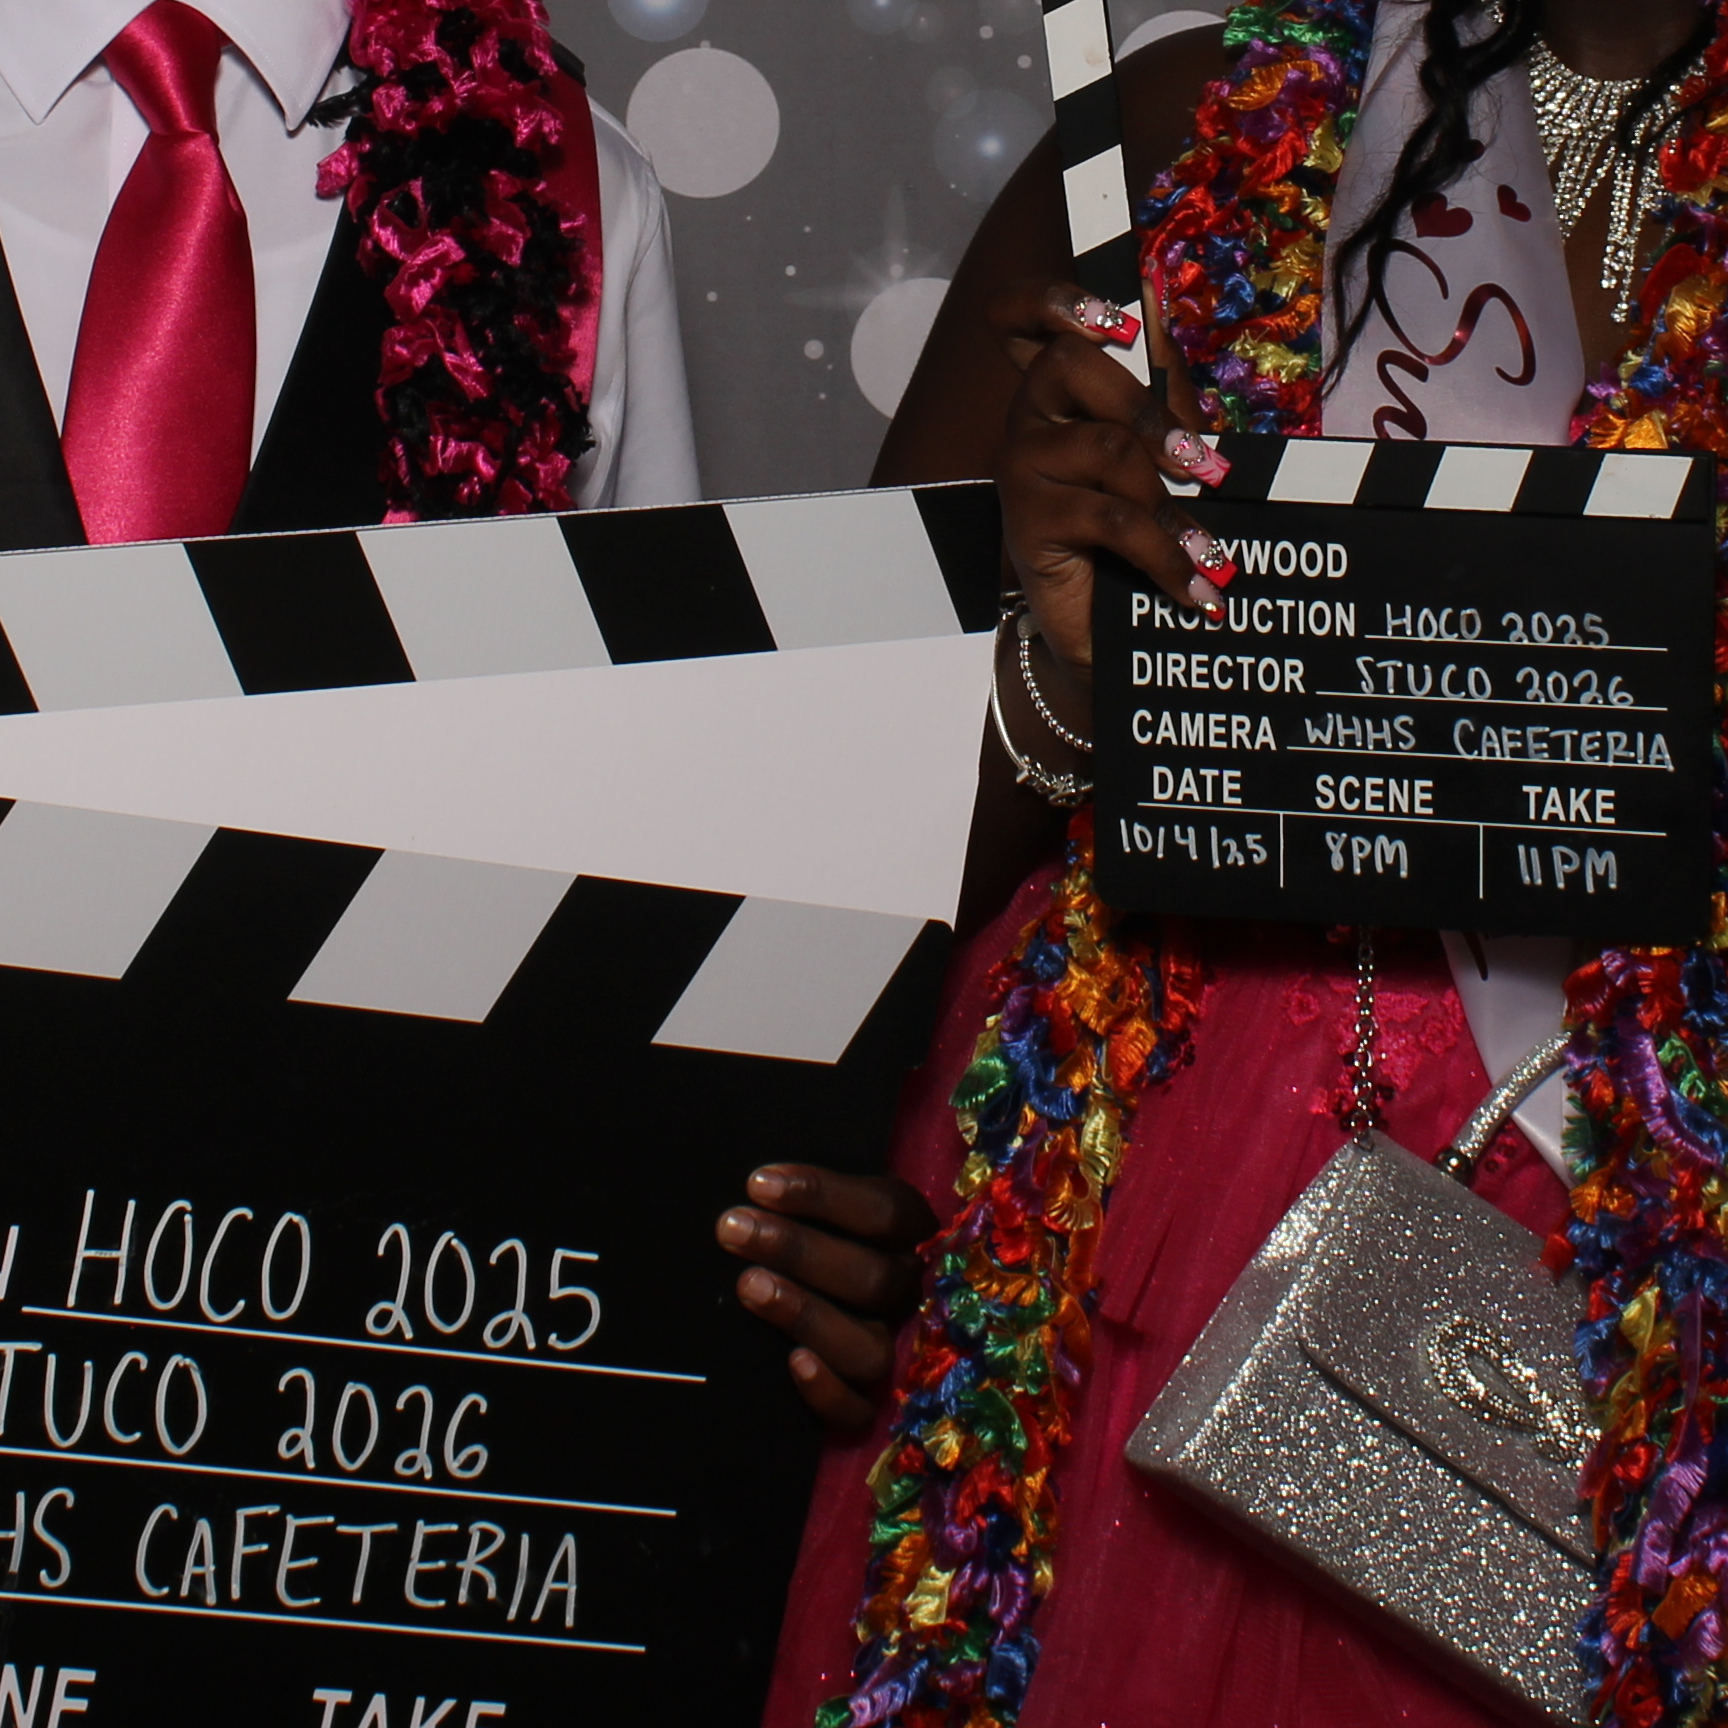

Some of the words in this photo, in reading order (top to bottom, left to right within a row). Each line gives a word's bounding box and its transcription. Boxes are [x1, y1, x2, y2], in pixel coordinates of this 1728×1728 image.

[1385, 603, 1482, 641] HOCO
[1502, 611, 1610, 647] 2025
[1132, 650, 1306, 694] DIRECTOR
[1355, 655, 1492, 700] STUCO
[1516, 666, 1634, 707] 2026
[1132, 709, 1277, 751] CAMERA
[1304, 712, 1416, 751] WHHS
[1454, 717, 1674, 772] CAFETERIA
[1152, 765, 1242, 805] DATE
[1314, 774, 1434, 815] SCENE
[1521, 784, 1616, 825] TAKE
[1325, 831, 1408, 879] 8PM
[66, 1188, 311, 1323] HOCO
[365, 1222, 601, 1351] 2025
[277, 1367, 489, 1480] 2026
[135, 1503, 577, 1628] CAFETERIA
